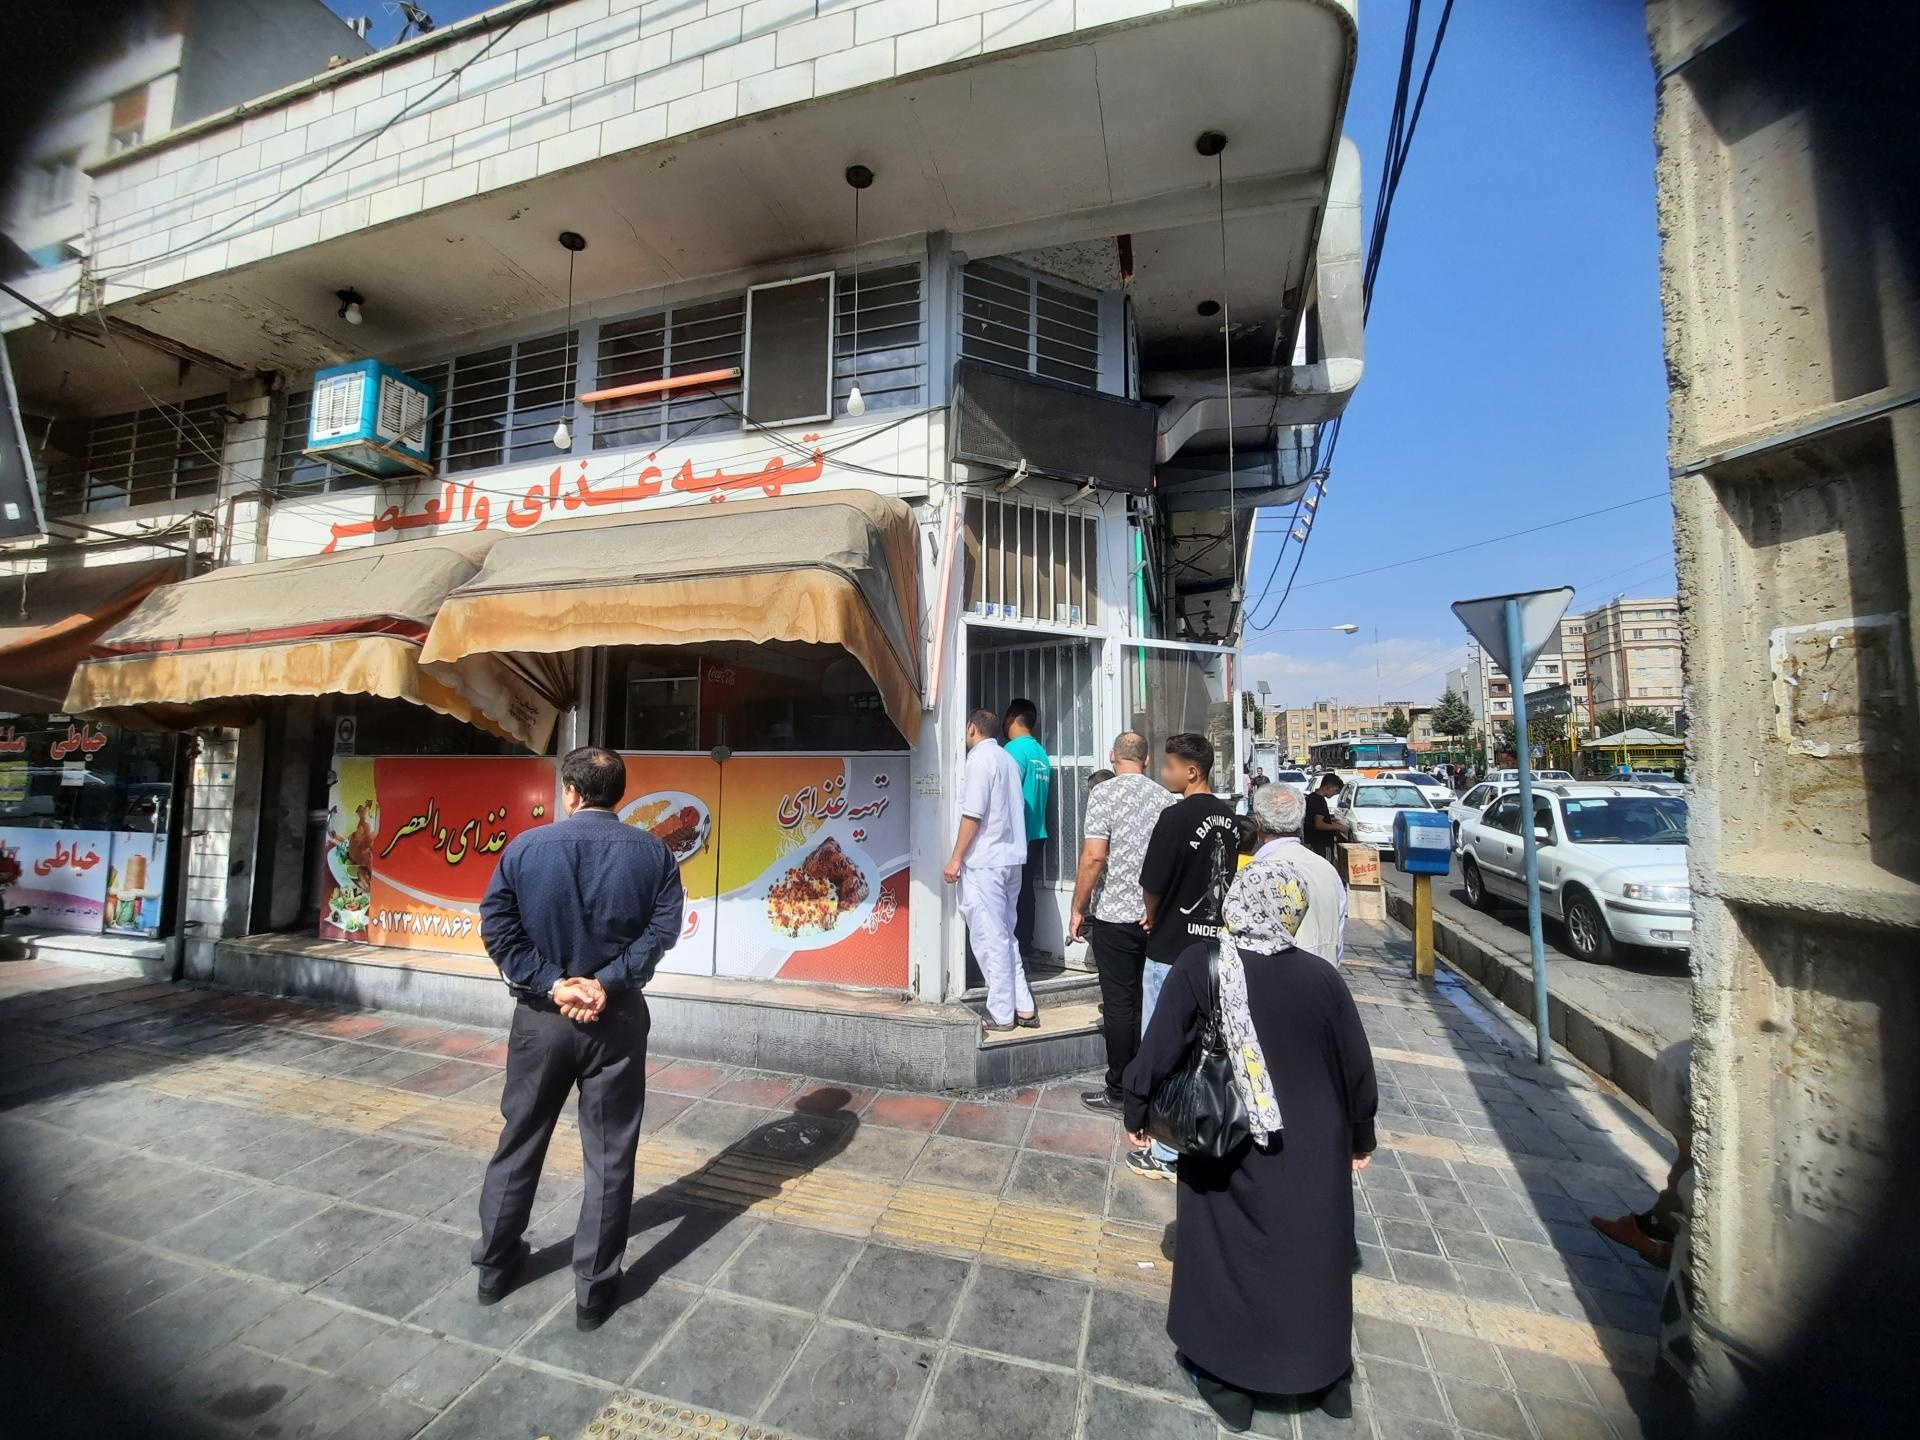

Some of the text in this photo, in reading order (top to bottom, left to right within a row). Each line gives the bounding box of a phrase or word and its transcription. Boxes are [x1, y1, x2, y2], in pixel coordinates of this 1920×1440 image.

[506, 452, 662, 528] غذای
[672, 434, 825, 503] تهیه
[50, 721, 107, 761] خیاطی
[381, 796, 508, 864] غذای والعصر
[777, 773, 889, 841] تهیه غذای
[1189, 839, 1201, 851] A
[1196, 814, 1232, 839] BATHING
[34, 840, 101, 877] خیاطی
[1350, 863, 1377, 875] Yekta
